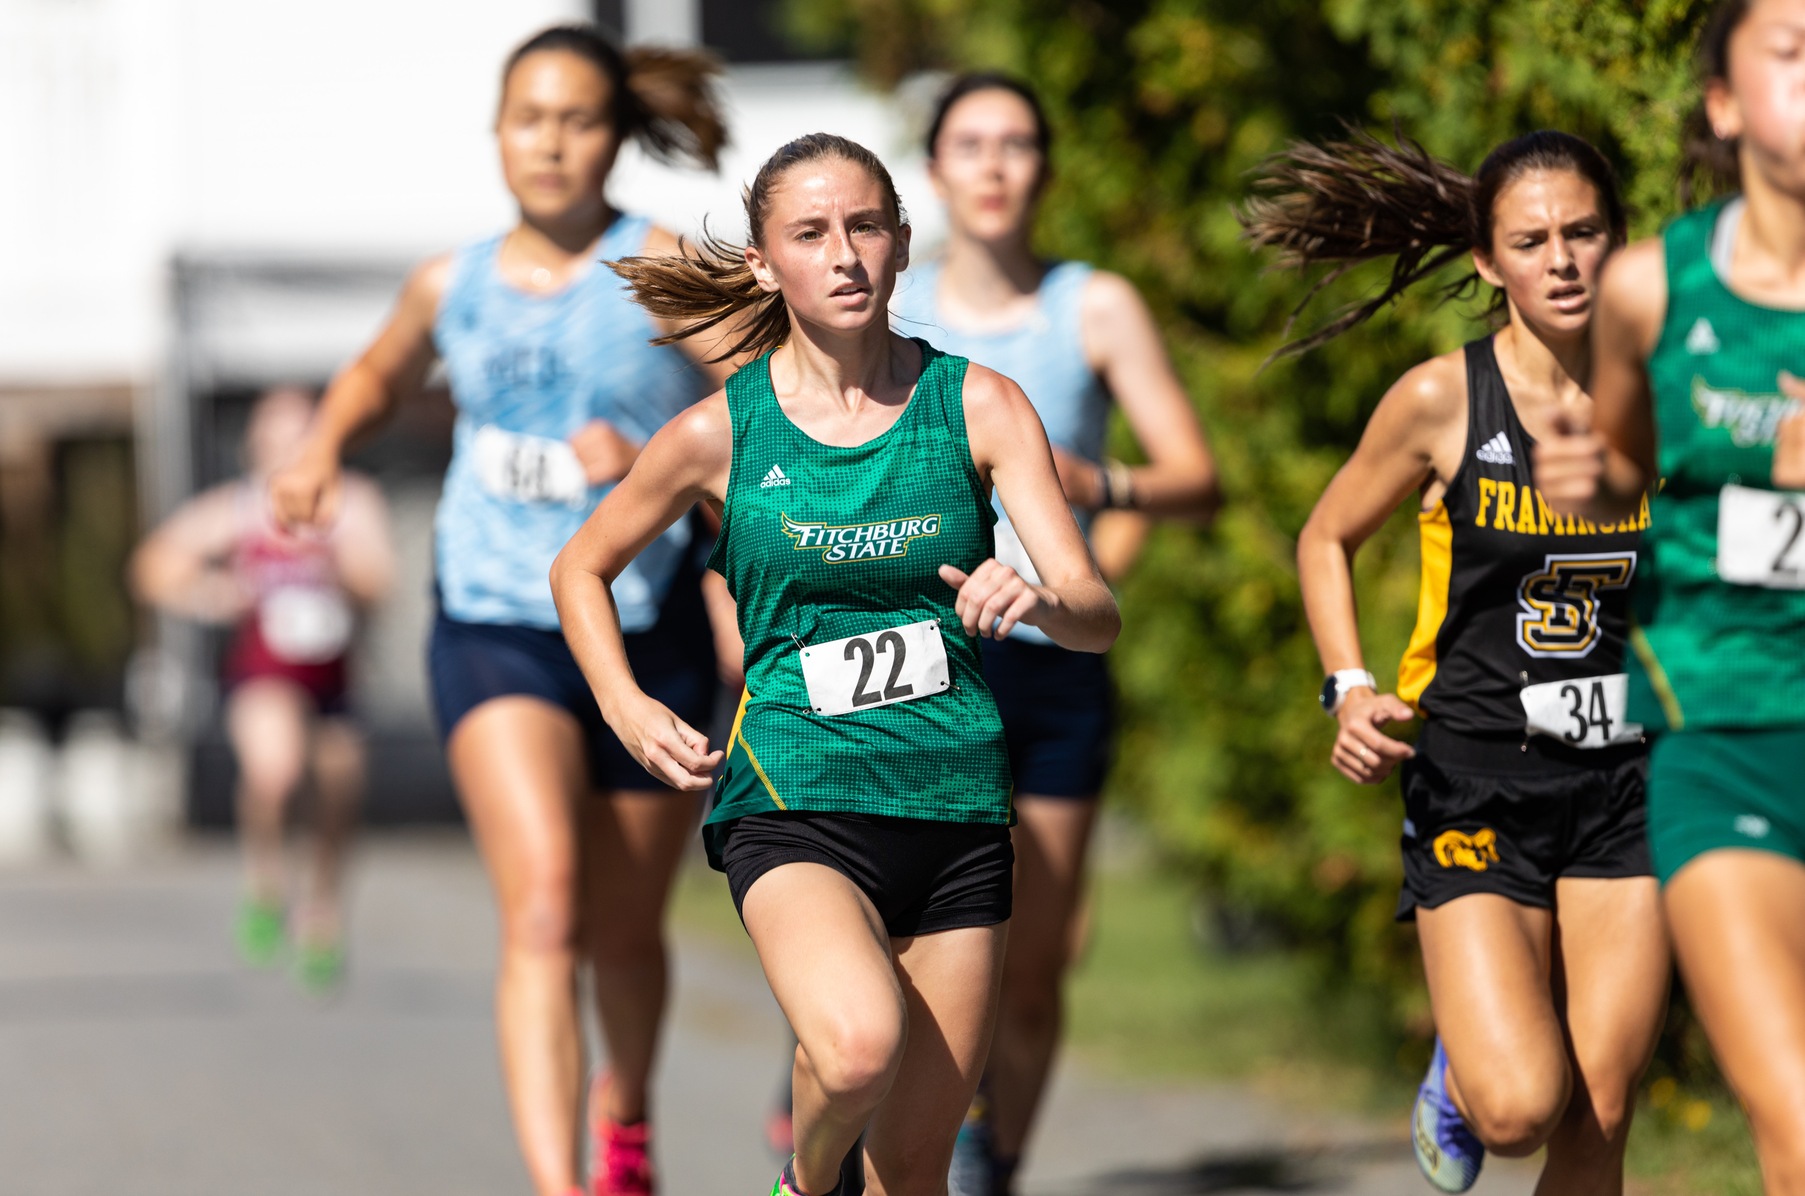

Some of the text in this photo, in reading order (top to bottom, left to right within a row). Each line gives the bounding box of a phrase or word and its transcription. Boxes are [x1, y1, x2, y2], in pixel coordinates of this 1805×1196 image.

[760, 477, 791, 489] adidas
[785, 516, 938, 547] FITCHBURG
[825, 537, 906, 561] STATE
[843, 630, 914, 708] 22
[1560, 681, 1613, 743] 34
